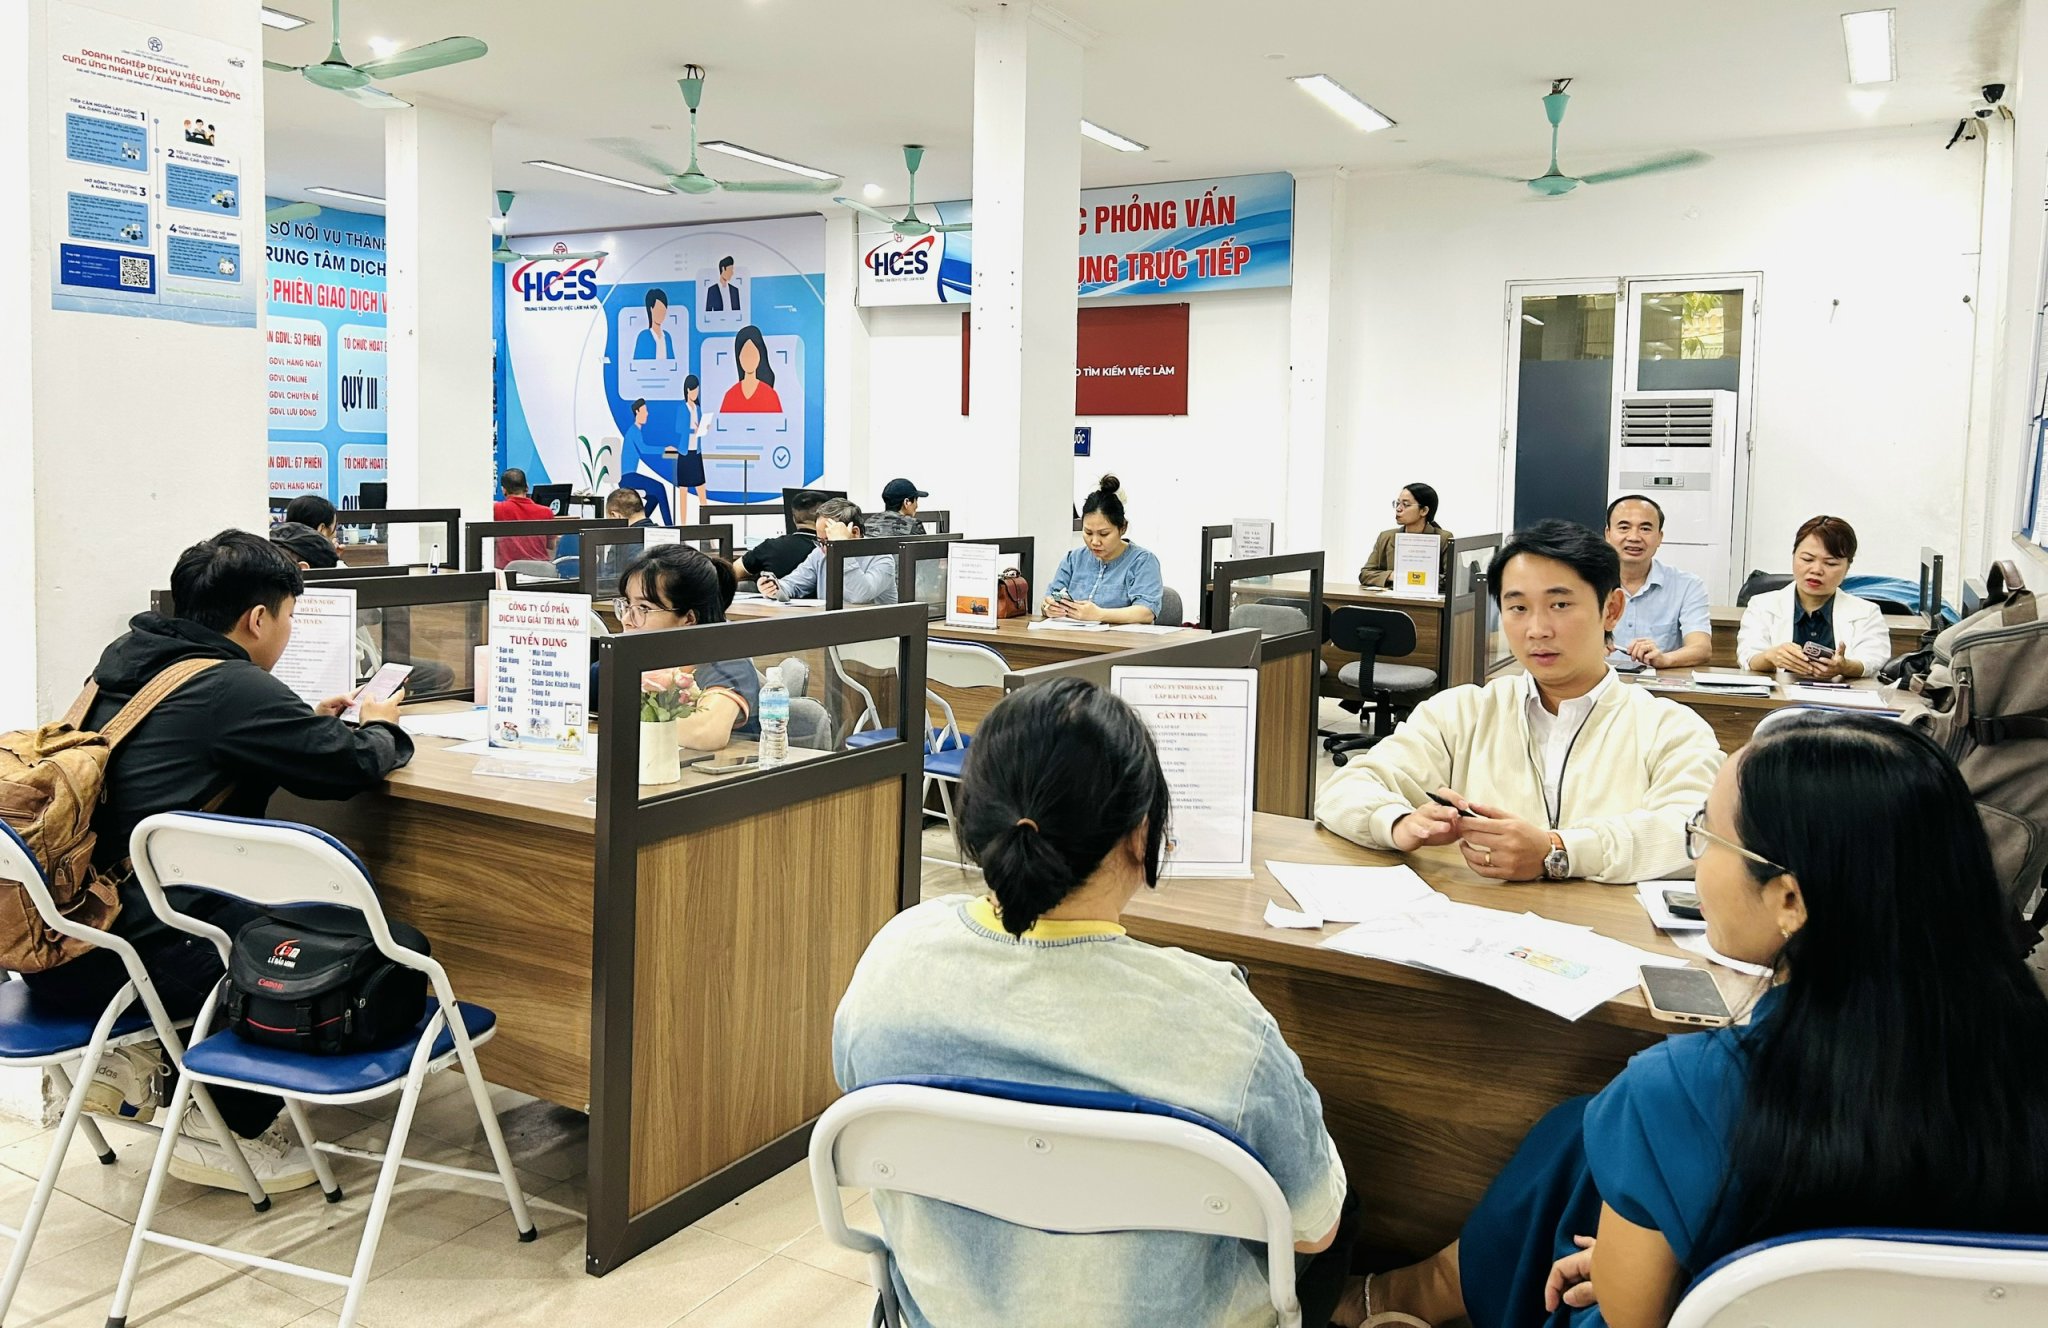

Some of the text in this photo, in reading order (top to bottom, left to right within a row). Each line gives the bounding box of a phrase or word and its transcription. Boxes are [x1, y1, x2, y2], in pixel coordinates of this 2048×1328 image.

[82, 49, 112, 60] DOANH
[115, 56, 145, 69] NGHIỆP
[170, 70, 180, 78] VỤ
[183, 72, 200, 82] VIỆC
[62, 54, 86, 65] CUNG
[88, 58, 107, 70] ỨNG
[109, 64, 132, 76] NHÂN
[134, 70, 149, 80] LỰC
[156, 74, 177, 85] XUẤT
[180, 80, 201, 91] KHẨU
[203, 86, 218, 94] LAO
[220, 89, 240, 100] ĐỘNG
[141, 112, 145, 121] 1
[168, 149, 174, 158] 2
[140, 187, 146, 196] 3
[1095, 194, 1176, 234] PHỎNG
[1185, 186, 1236, 228] VẤN
[170, 224, 177, 232] 4
[295, 222, 318, 242] NỘI
[323, 229, 341, 246] VỤ
[266, 246, 386, 278] RUNG TÂM DỊCH
[875, 250, 928, 276] HCES
[1126, 248, 1188, 286] TRỰC
[1196, 238, 1250, 277] TIẾP
[524, 269, 597, 302] HCES
[274, 277, 313, 305] PHIÊN
[317, 284, 345, 309] GIAO
[350, 288, 378, 315] DỊCH
[294, 333, 301, 346] 53
[287, 375, 307, 383] ONLINE
[1083, 366, 1100, 376] TÌM
[1103, 365, 1126, 376] KIẾM
[1128, 365, 1151, 378] VIỆC
[1153, 365, 1174, 375] LÀM
[342, 369, 363, 412] QUÝ
[367, 377, 377, 409] III
[295, 457, 302, 468] 67
[508, 601, 527, 611] CÔNG
[540, 601, 550, 612] CỔ
[551, 603, 570, 613] PHẦN
[499, 614, 514, 624] DỊCH
[556, 615, 565, 625] HÀ
[567, 616, 579, 628] NỘI
[510, 632, 567, 649] TUYỂN DỤNG
[258, 978, 284, 990] Canon
